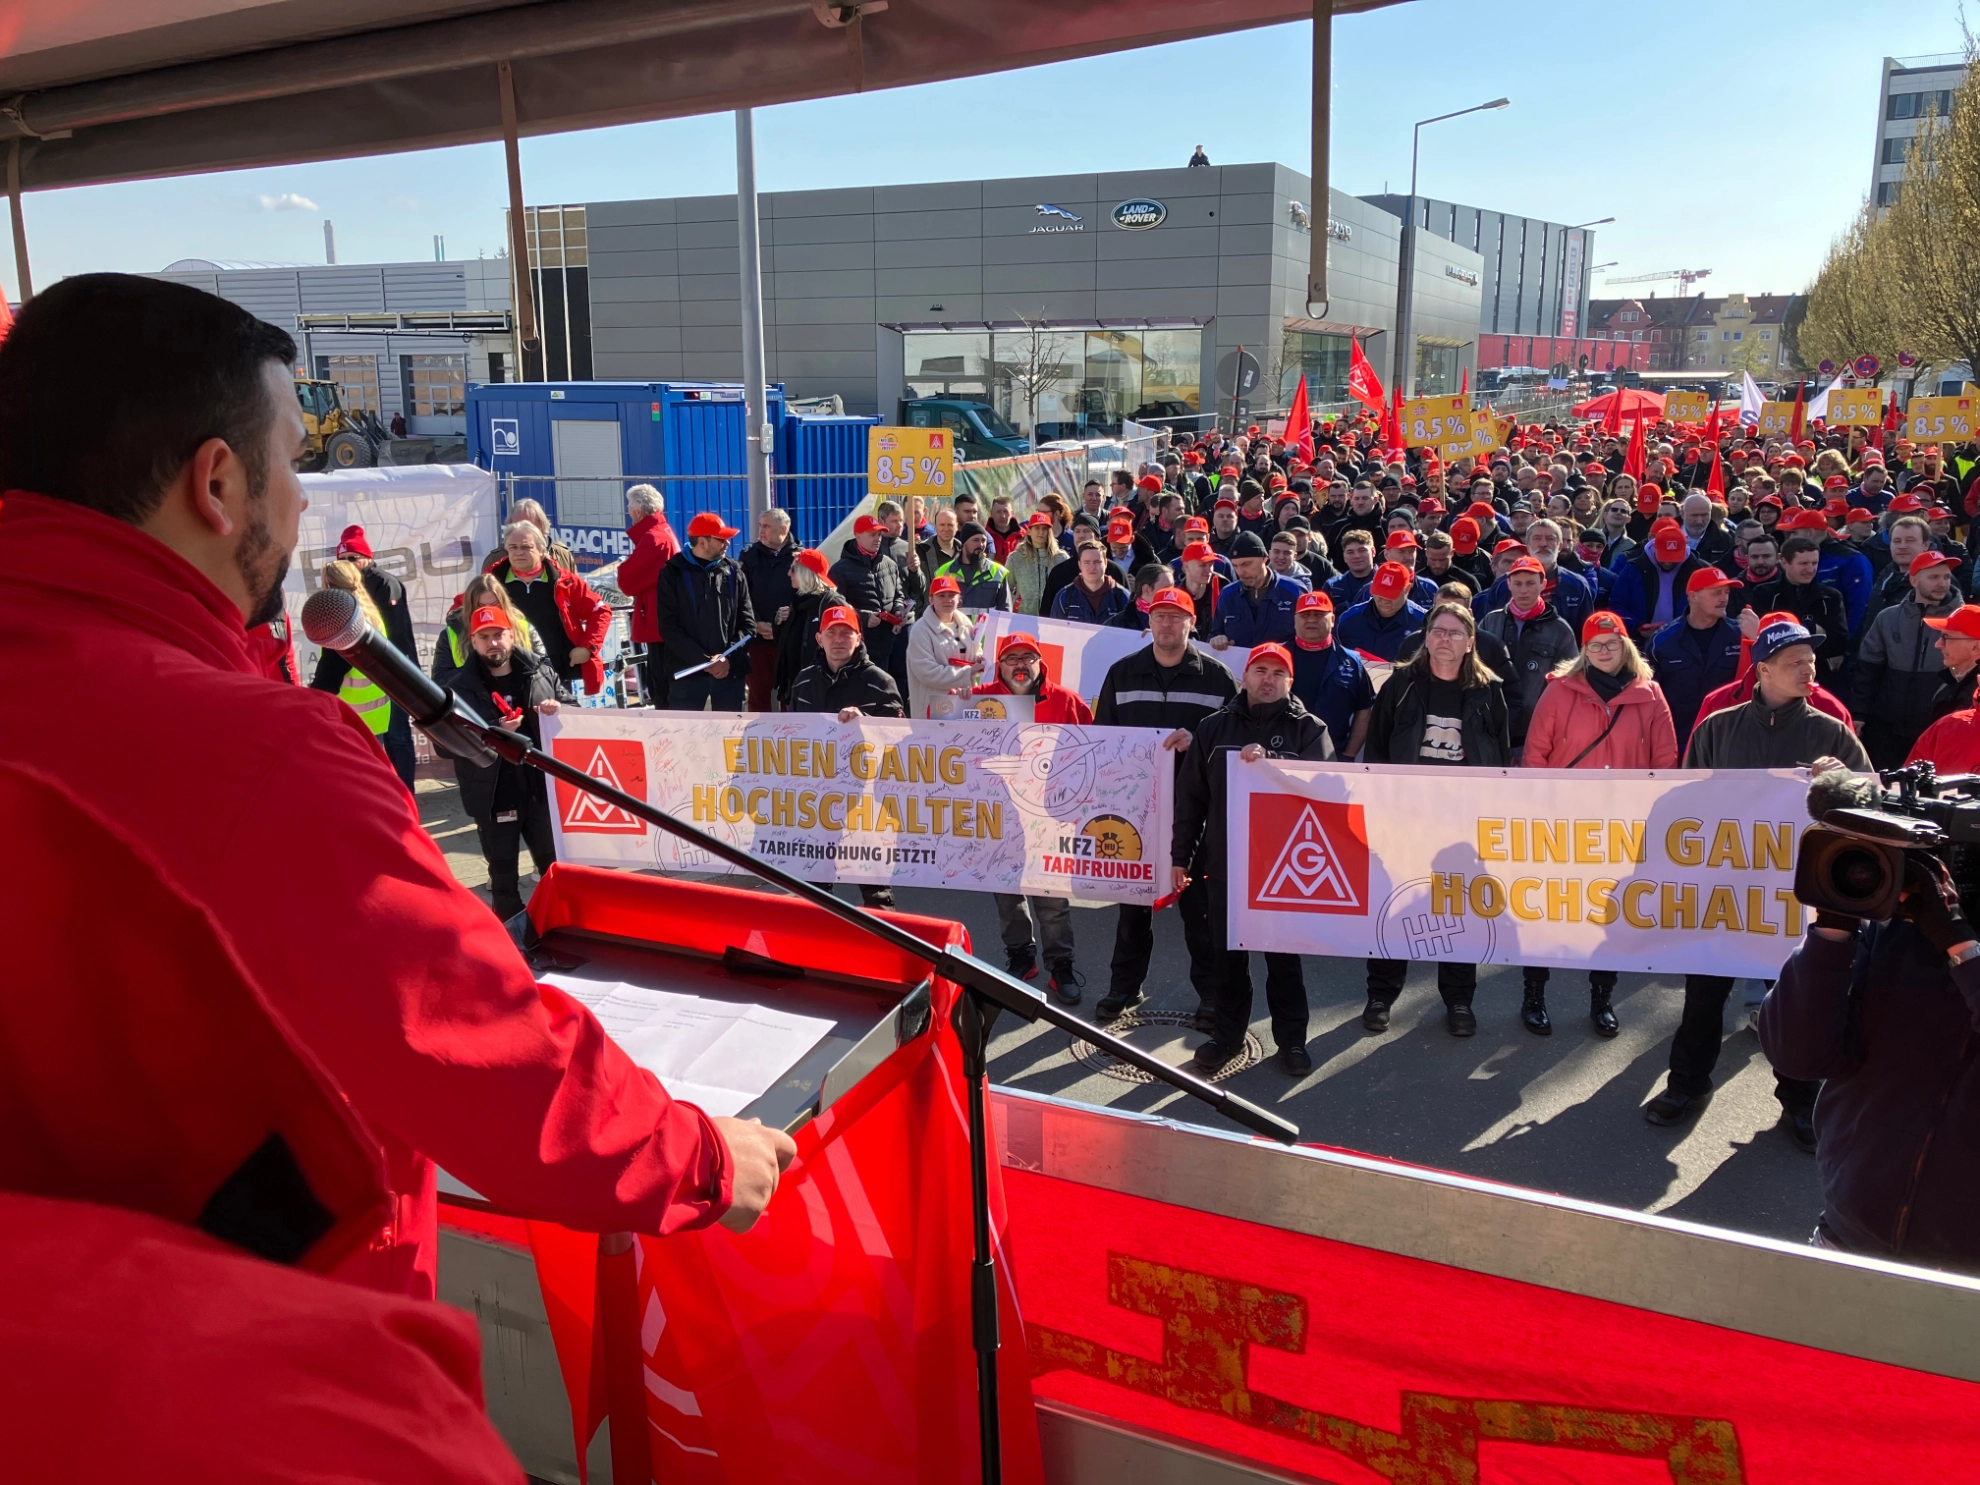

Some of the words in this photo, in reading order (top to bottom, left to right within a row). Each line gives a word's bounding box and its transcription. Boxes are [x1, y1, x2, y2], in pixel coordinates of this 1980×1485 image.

[1122, 204, 1148, 215] LAND
[1124, 213, 1156, 224] ROVER
[1029, 224, 1085, 233] JAGUAR
[1668, 403, 1688, 418] 8,5
[1690, 405, 1702, 418] %
[1832, 404, 1857, 421] 8,5
[1860, 404, 1876, 420] %
[1413, 417, 1443, 440] 8,5
[1446, 415, 1466, 436] %
[1764, 415, 1786, 431] 8,5
[1914, 416, 1946, 438] 8,5
[1950, 415, 1969, 435] %
[1475, 428, 1493, 447] %
[877, 455, 915, 489] 8,5
[920, 456, 946, 486] %
[964, 710, 980, 719] KFZ
[723, 736, 837, 779] EINEN
[850, 740, 967, 786] GANG
[692, 783, 1003, 841] HOCHSCHALTEN
[759, 839, 882, 861] TARIFERHÖHUNG
[885, 847, 936, 865] JETZT!
[1059, 836, 1092, 857] KFZ
[1104, 843, 1116, 851] HU
[1477, 816, 1647, 864] EINEN
[1665, 816, 1796, 871] GAN
[1042, 855, 1153, 881] TARIFRUNDE
[1430, 872, 1804, 938] HOCHSCHALT
